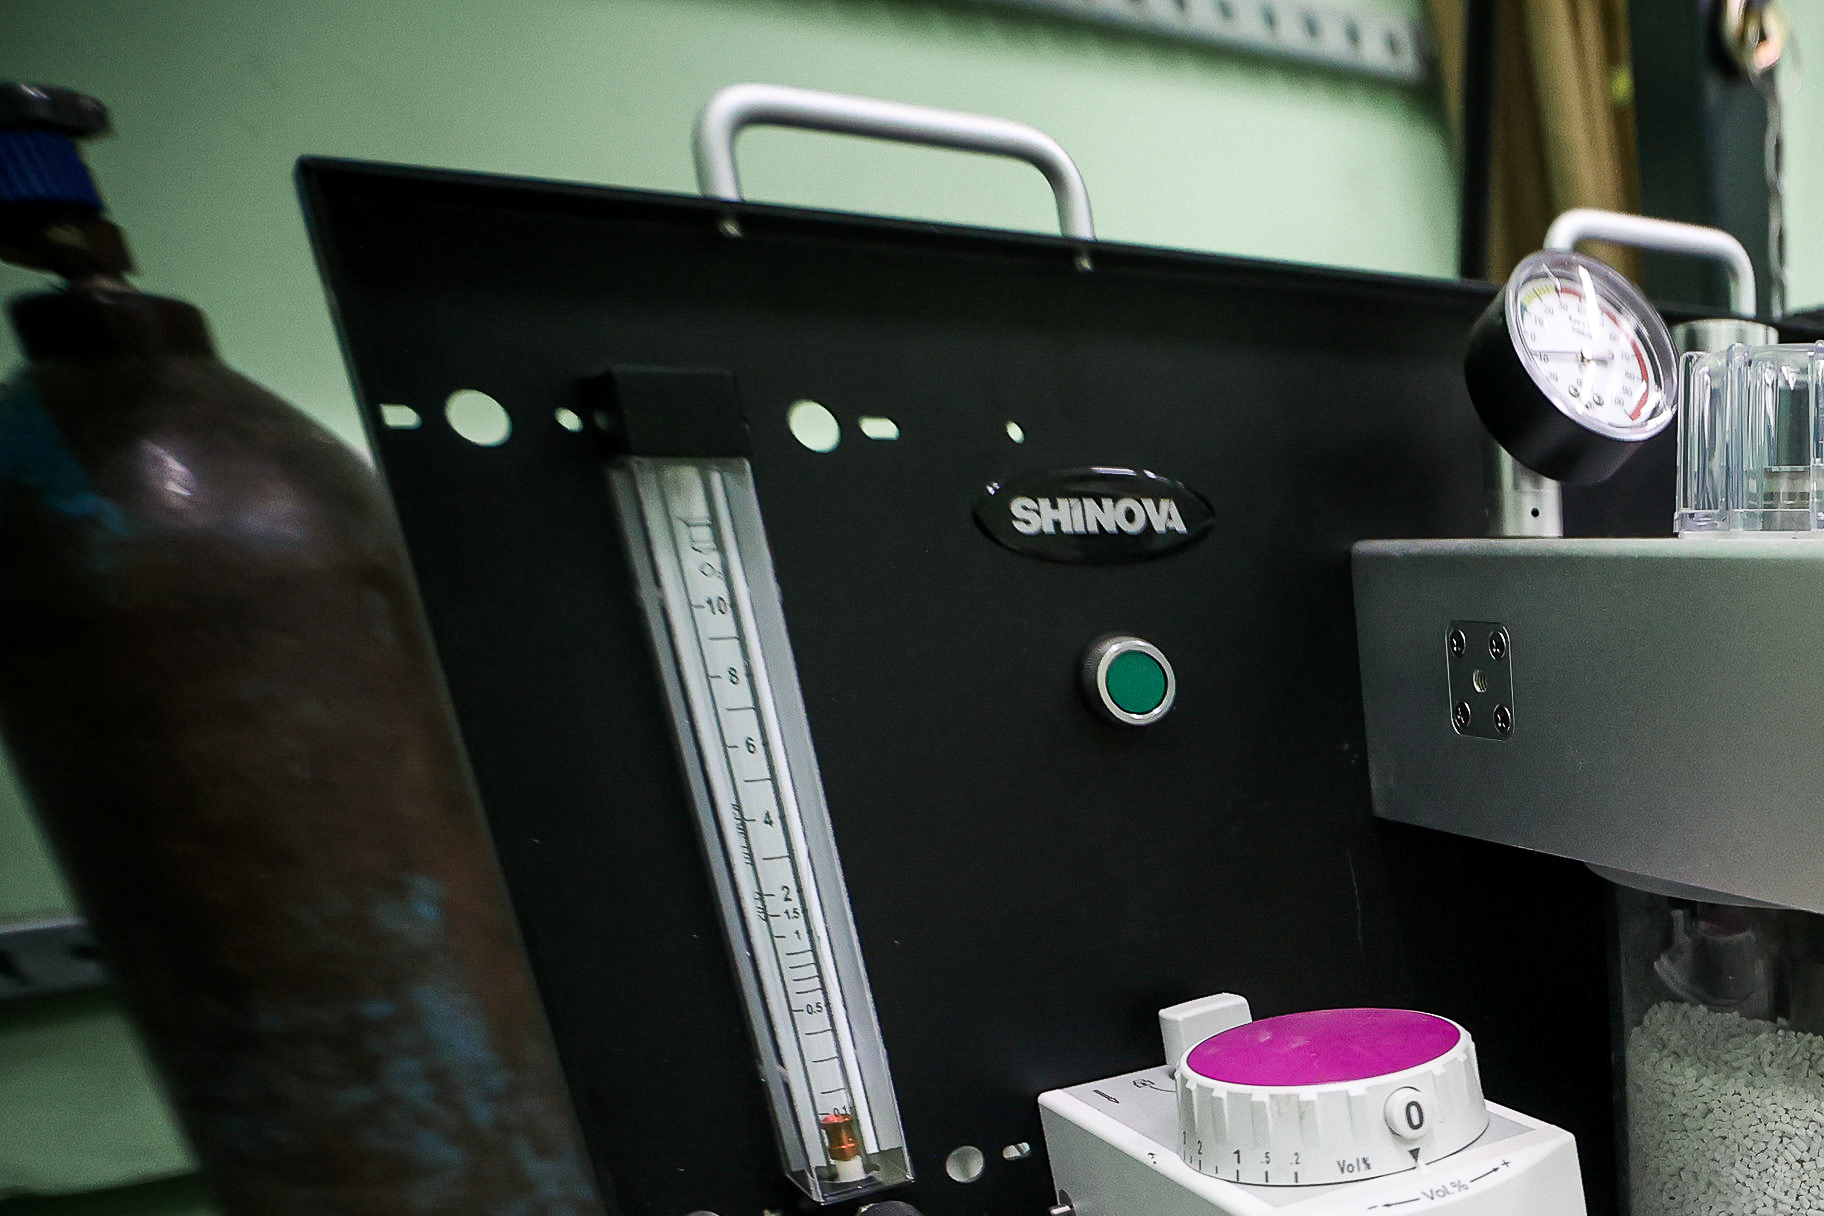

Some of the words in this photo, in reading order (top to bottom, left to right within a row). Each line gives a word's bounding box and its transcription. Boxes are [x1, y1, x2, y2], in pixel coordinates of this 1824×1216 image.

[1010, 496, 1188, 535] SHINOVA
[706, 596, 727, 615] 10
[728, 666, 740, 685] 8
[745, 736, 757, 754] 6
[763, 810, 774, 827] 4
[781, 885, 793, 902] 2
[805, 1001, 823, 1015] 0.5
[1405, 1101, 1424, 1131] 0
[1233, 1149, 1241, 1164] 1
